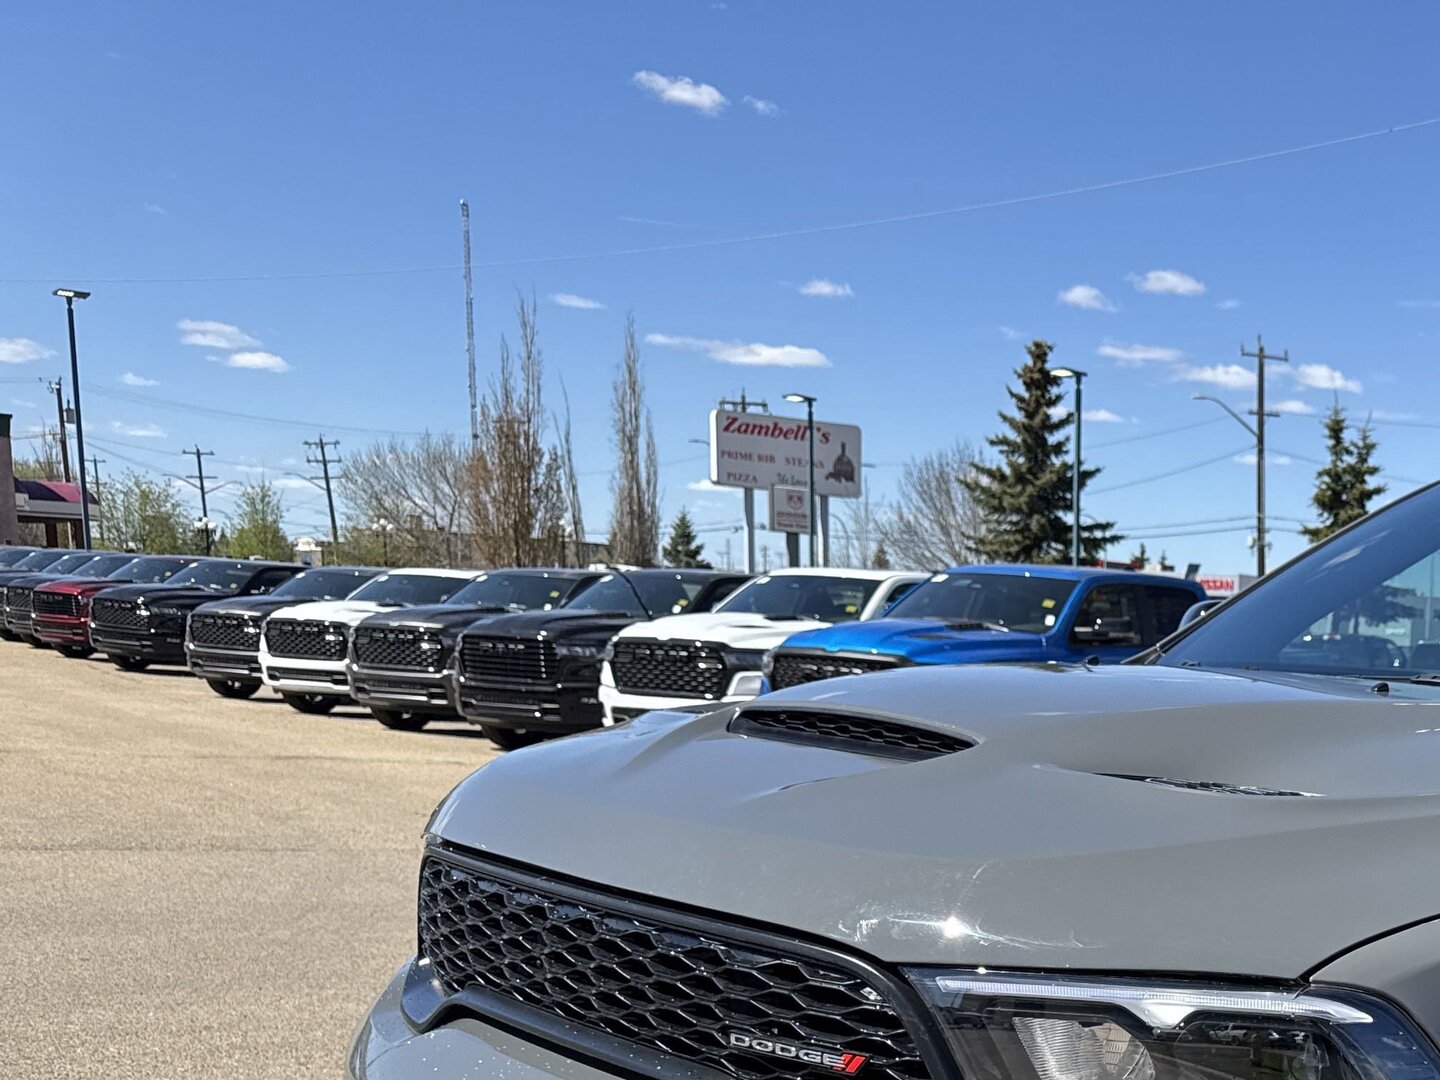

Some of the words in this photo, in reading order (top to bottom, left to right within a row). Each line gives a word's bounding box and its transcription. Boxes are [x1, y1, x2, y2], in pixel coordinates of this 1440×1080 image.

[722, 415, 832, 445] Zambell's
[720, 449, 755, 462] PRIME
[757, 453, 776, 464] RIB
[726, 471, 758, 484] PIZZA
[730, 1032, 848, 1068] DODGE
